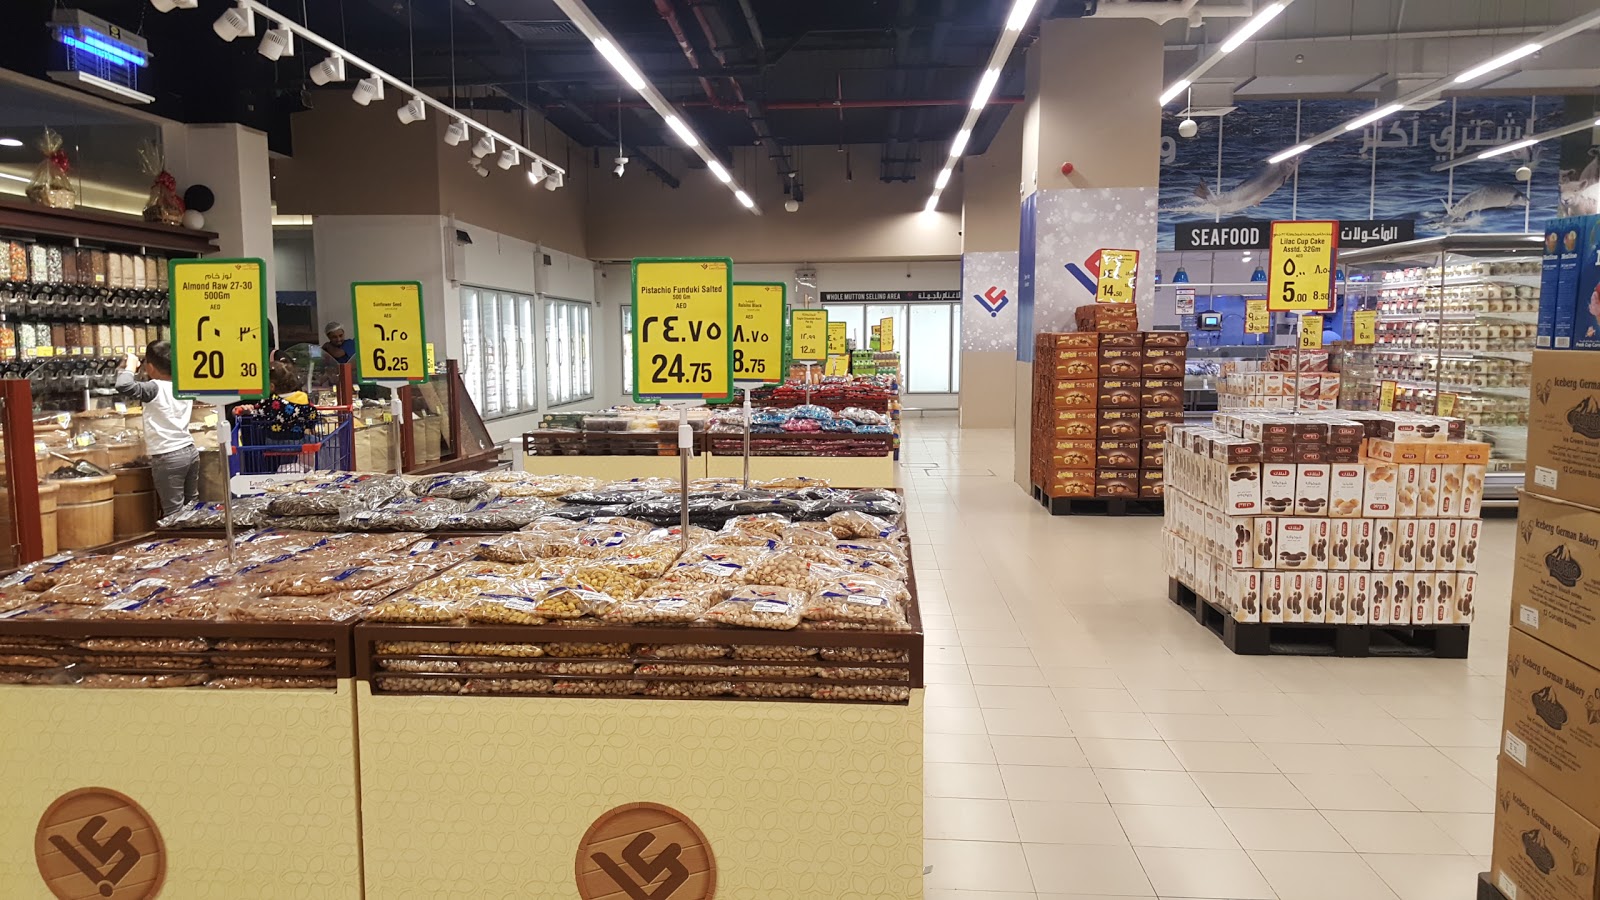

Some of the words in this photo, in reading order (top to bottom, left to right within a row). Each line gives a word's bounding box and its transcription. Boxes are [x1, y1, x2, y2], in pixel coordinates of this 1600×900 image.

[1191, 227, 1260, 246] SEAFOOD
[1297, 238, 1309, 246] Cup
[1340, 226, 1398, 242] المأكولات
[183, 282, 210, 290] Almond
[212, 282, 228, 290] Raw
[230, 281, 252, 290] 27-30
[204, 291, 230, 300] 500Gm
[641, 286, 671, 294] Pistachio
[701, 285, 723, 293] Salted
[1102, 284, 1122, 297] 14.50
[1283, 281, 1307, 302] 5.00
[1313, 290, 1330, 300] 8.50
[642, 316, 722, 343] ٢٤.٧٥
[193, 350, 225, 379] 20
[241, 362, 257, 377] 30
[373, 348, 409, 371] 6.25
[651, 353, 712, 384] 24.75
[733, 349, 766, 373] 8.75
[1554, 377, 1577, 390] Iceberg
[1579, 378, 1600, 390] Germa
[1535, 519, 1555, 536] Iceberg
[1556, 525, 1578, 541] German
[1578, 532, 1599, 550] Bakery
[1522, 655, 1541, 675] Iceberg
[1542, 667, 1563, 685] German
[1565, 678, 1586, 699] Bakery
[1531, 808, 1551, 831] German
[1552, 825, 1571, 848] Bakery
